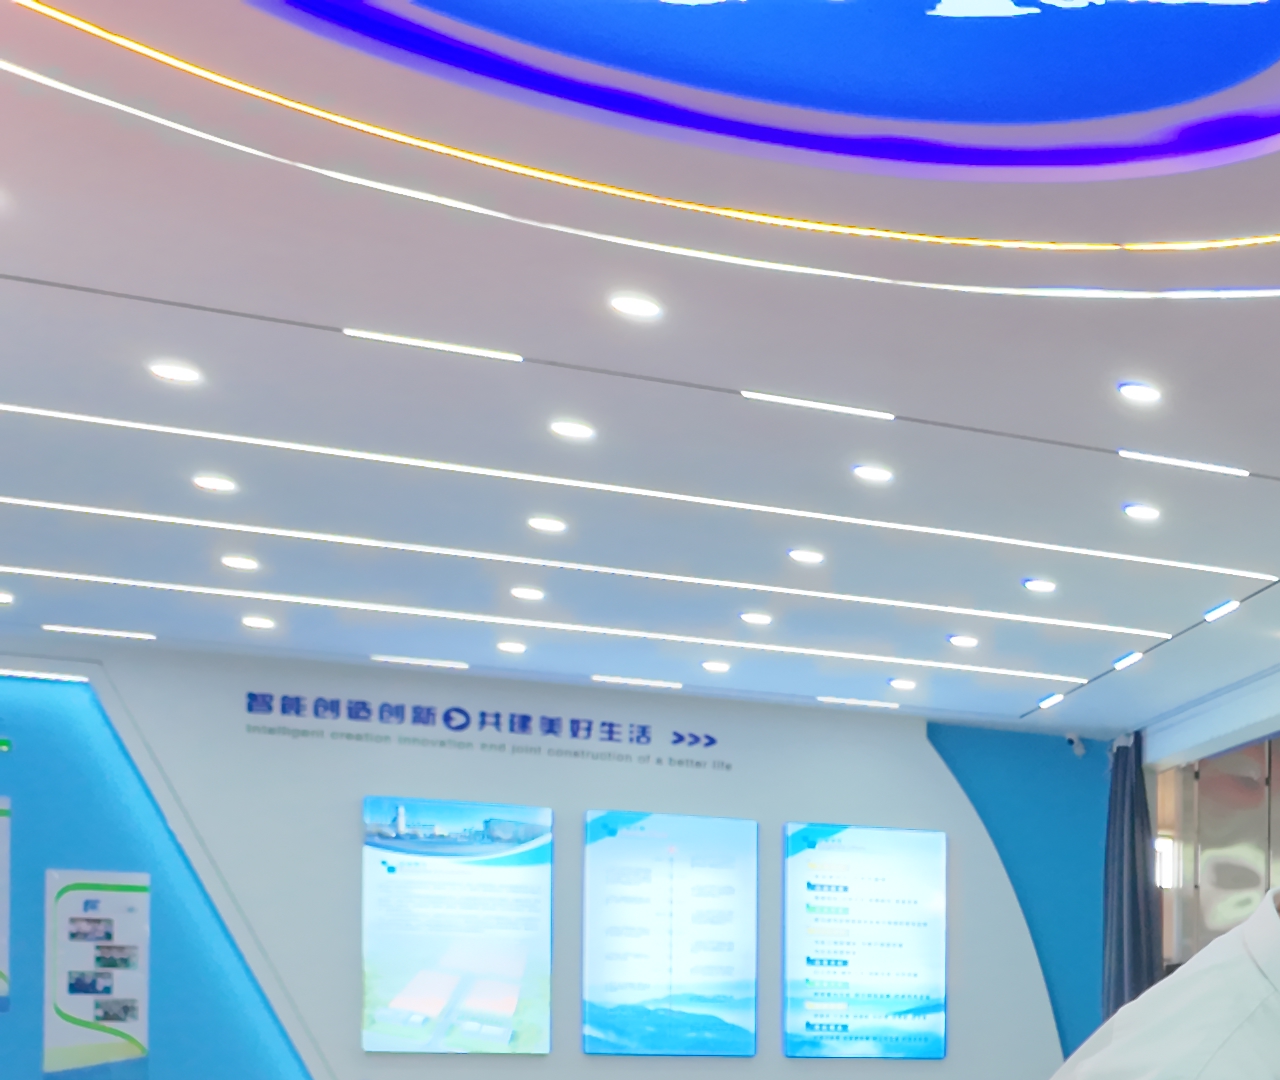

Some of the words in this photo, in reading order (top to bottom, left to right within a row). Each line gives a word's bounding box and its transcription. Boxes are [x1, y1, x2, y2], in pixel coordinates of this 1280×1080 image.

[478, 710, 653, 746] 共建美好生活
[330, 731, 392, 744] creation
[397, 736, 474, 750] innovation
[510, 744, 541, 756] joint
[547, 747, 632, 763] construction
[638, 753, 650, 765] of
[669, 756, 707, 770] better
[712, 759, 733, 772] life
